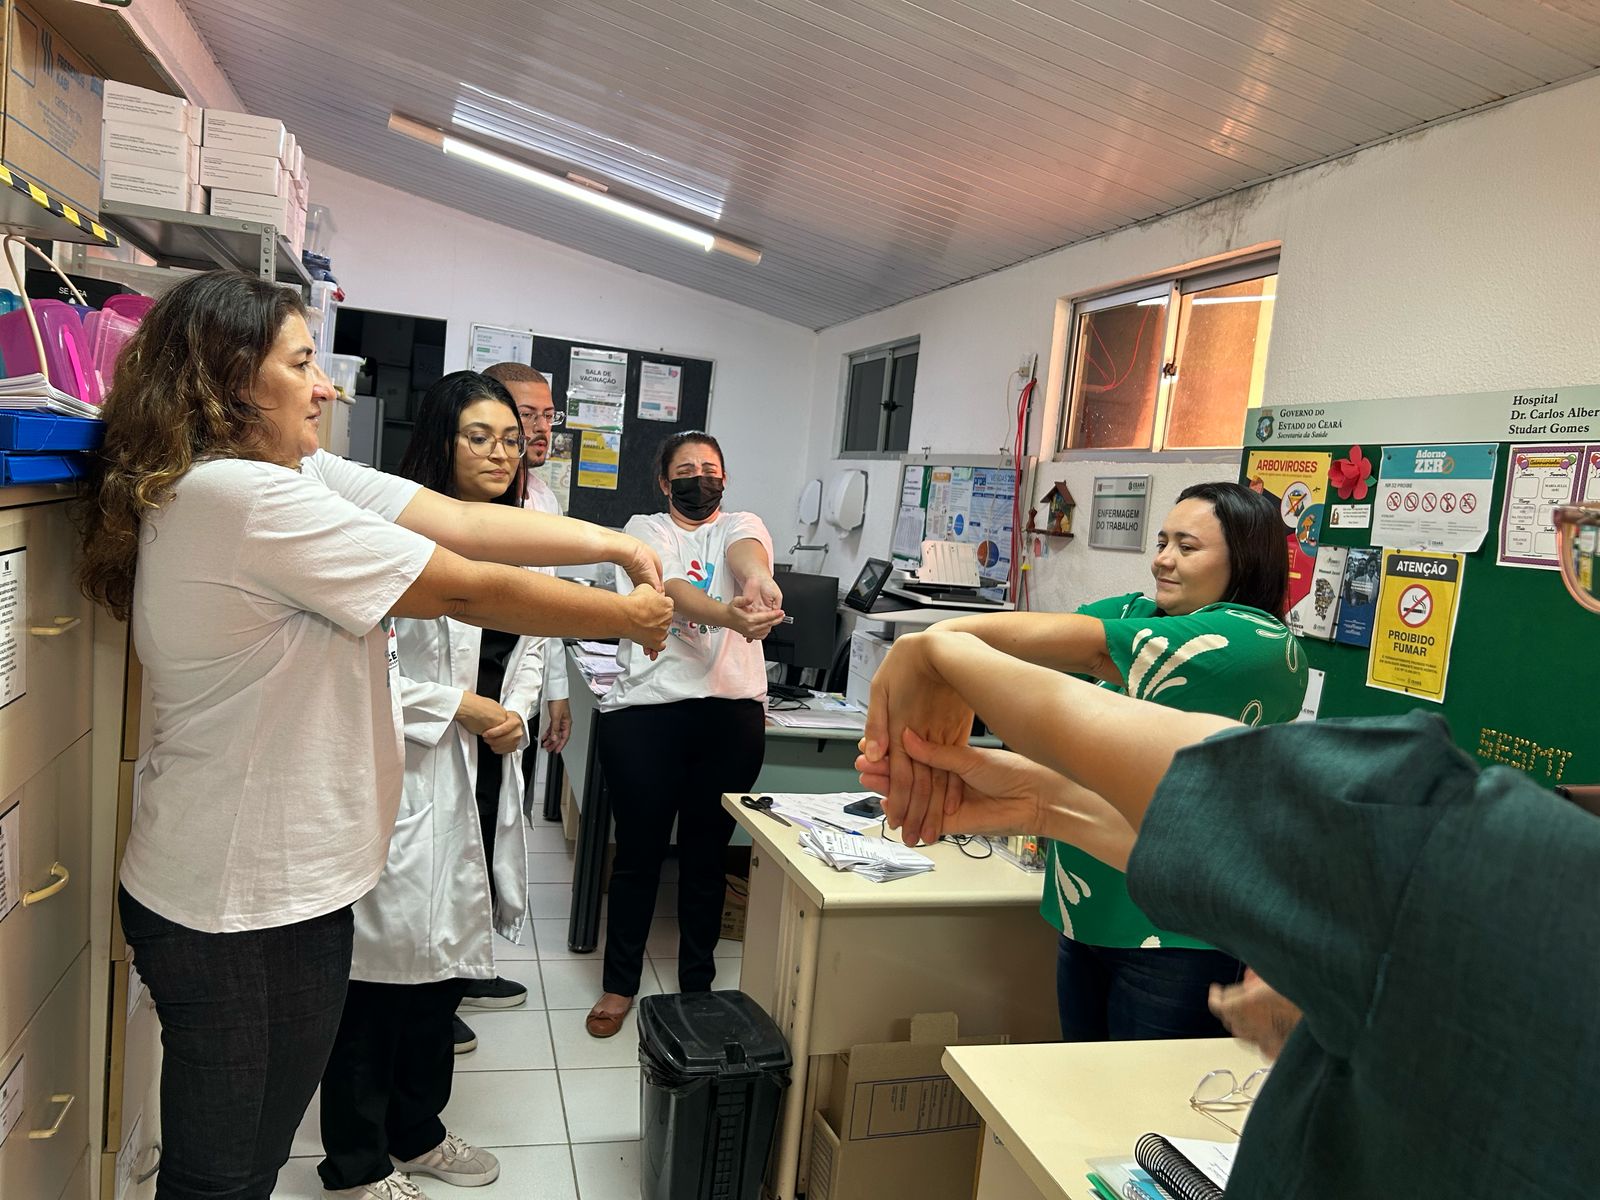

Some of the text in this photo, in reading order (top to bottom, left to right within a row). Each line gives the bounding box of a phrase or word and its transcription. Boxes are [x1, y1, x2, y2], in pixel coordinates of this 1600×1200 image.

[58, 287, 87, 298] SE LGA
[585, 368, 602, 376] SALA
[580, 375, 617, 385] VACINAÇÃO
[1512, 393, 1558, 407] Hospital
[1280, 408, 1313, 418] GOVERNO
[1510, 407, 1600, 420] Dr. Carlos Alber
[1278, 421, 1305, 430] ESTADO
[1318, 419, 1343, 429] CEARÁ
[1508, 422, 1590, 435] Studart Gomes
[1277, 431, 1303, 439] Secretaria
[1311, 430, 1329, 438] Saúde
[1415, 449, 1447, 459] Adorno
[1256, 459, 1318, 473] ARBOVIROSES
[1097, 508, 1140, 519] ENFERMAGEM
[1096, 520, 1139, 531] DO TRABALHO
[1396, 560, 1448, 577] ATENÇÃO
[1388, 629, 1435, 646] PROIBIDO
[1393, 642, 1427, 656] FUMAR
[1477, 728, 1573, 780] SESMT
